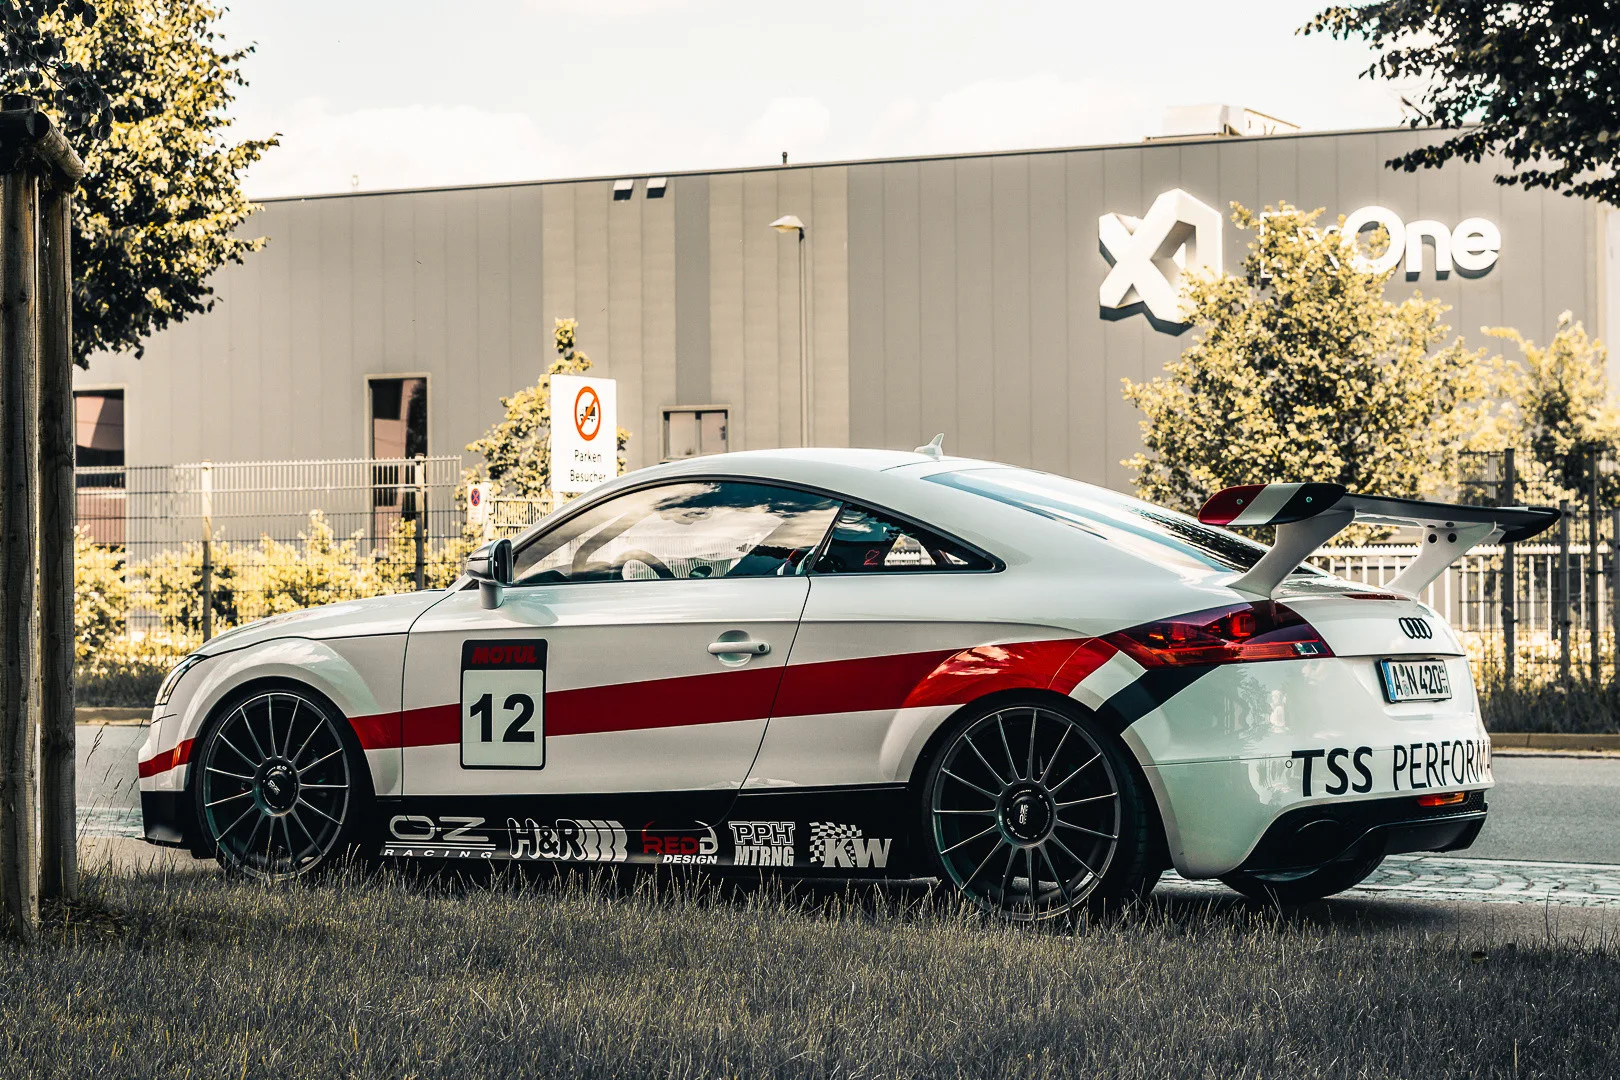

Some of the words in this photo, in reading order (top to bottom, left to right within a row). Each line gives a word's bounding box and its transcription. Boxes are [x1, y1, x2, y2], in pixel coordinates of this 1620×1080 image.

[574, 449, 602, 462] Parken
[570, 469, 607, 483] Besucher
[472, 645, 537, 664] MOTUL
[470, 693, 535, 743] 12
[1291, 747, 1373, 798] TSS
[507, 817, 584, 861] H&R
[728, 821, 796, 846] PPH
[383, 849, 493, 859] RACING
[662, 854, 718, 865] DESIGN
[734, 846, 794, 867] MTRNG
[822, 838, 893, 868] KW
